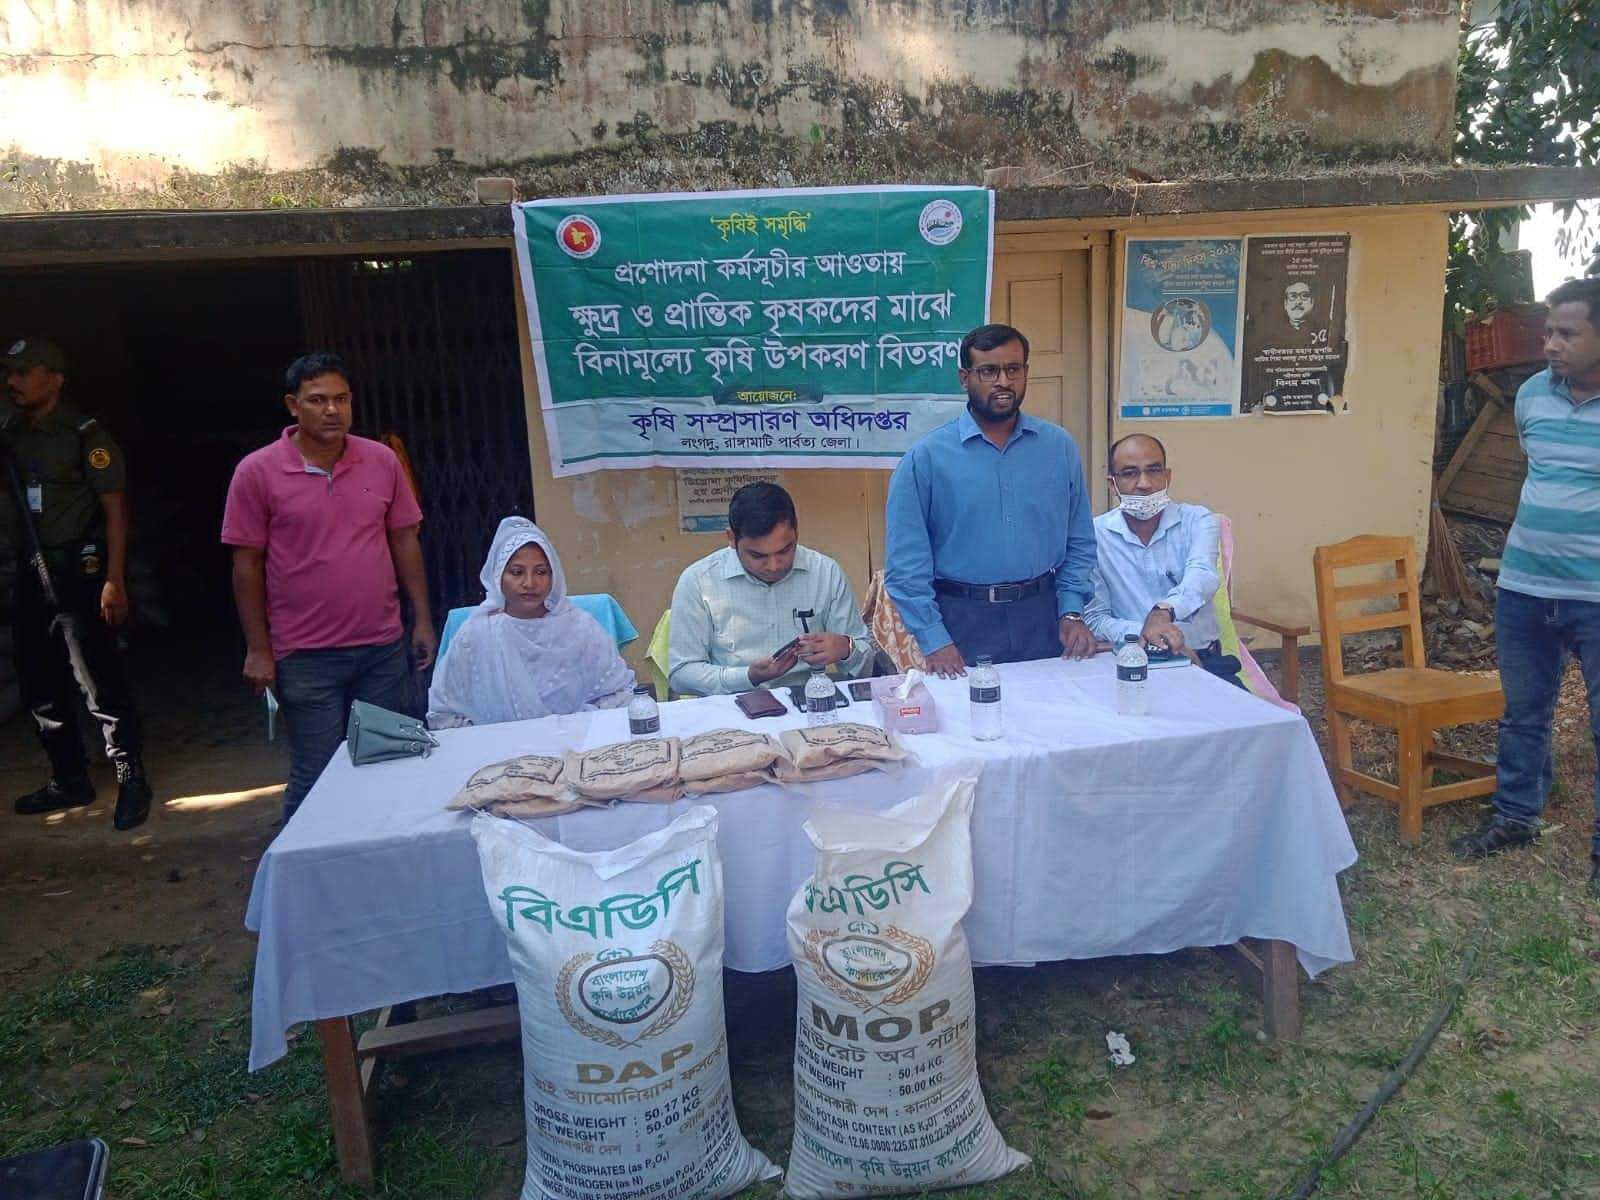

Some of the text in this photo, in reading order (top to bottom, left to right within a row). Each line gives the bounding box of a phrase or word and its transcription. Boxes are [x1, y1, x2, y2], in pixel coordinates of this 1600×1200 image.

[615, 248, 907, 288] প্রণোদনা কর্মসূচীর আওতায়
[568, 288, 956, 339] ক্ষুদ্র ও প্রান্তিক কৃষকদের মাঝে
[573, 334, 962, 384] বিনামূল্যে কৃষি উপকরণ বিতরণ
[629, 404, 911, 439] কৃষি সম্প্রসারণ অধিদপ্তর
[724, 433, 773, 450] রাঙ্গামাটি
[779, 432, 815, 450] পার্বত্য
[811, 999, 951, 1043] MOP
[874, 1046, 919, 1064] অব
[927, 1016, 970, 1049] পটাশ
[576, 1042, 694, 1084] DAP
[822, 1056, 864, 1080] WEIGHT
[898, 1064, 925, 1081] 50.14
[809, 1064, 846, 1092] WEIGHT
[899, 1079, 926, 1097] 50.00
[555, 1125, 606, 1141] WEIGHT
[646, 1111, 679, 1134] 50.00
[573, 1114, 626, 1128] WEIGHT
[644, 1098, 678, 1122] 50.17
[816, 1106, 849, 1129] POTASH
[852, 1121, 896, 1136] CONTENT
[563, 1160, 626, 1176] PHOSPHATES
[565, 1175, 613, 1190] NITROGEN
[856, 1156, 885, 1181] কৃষি
[888, 1158, 931, 1179] উন্নয়ন
